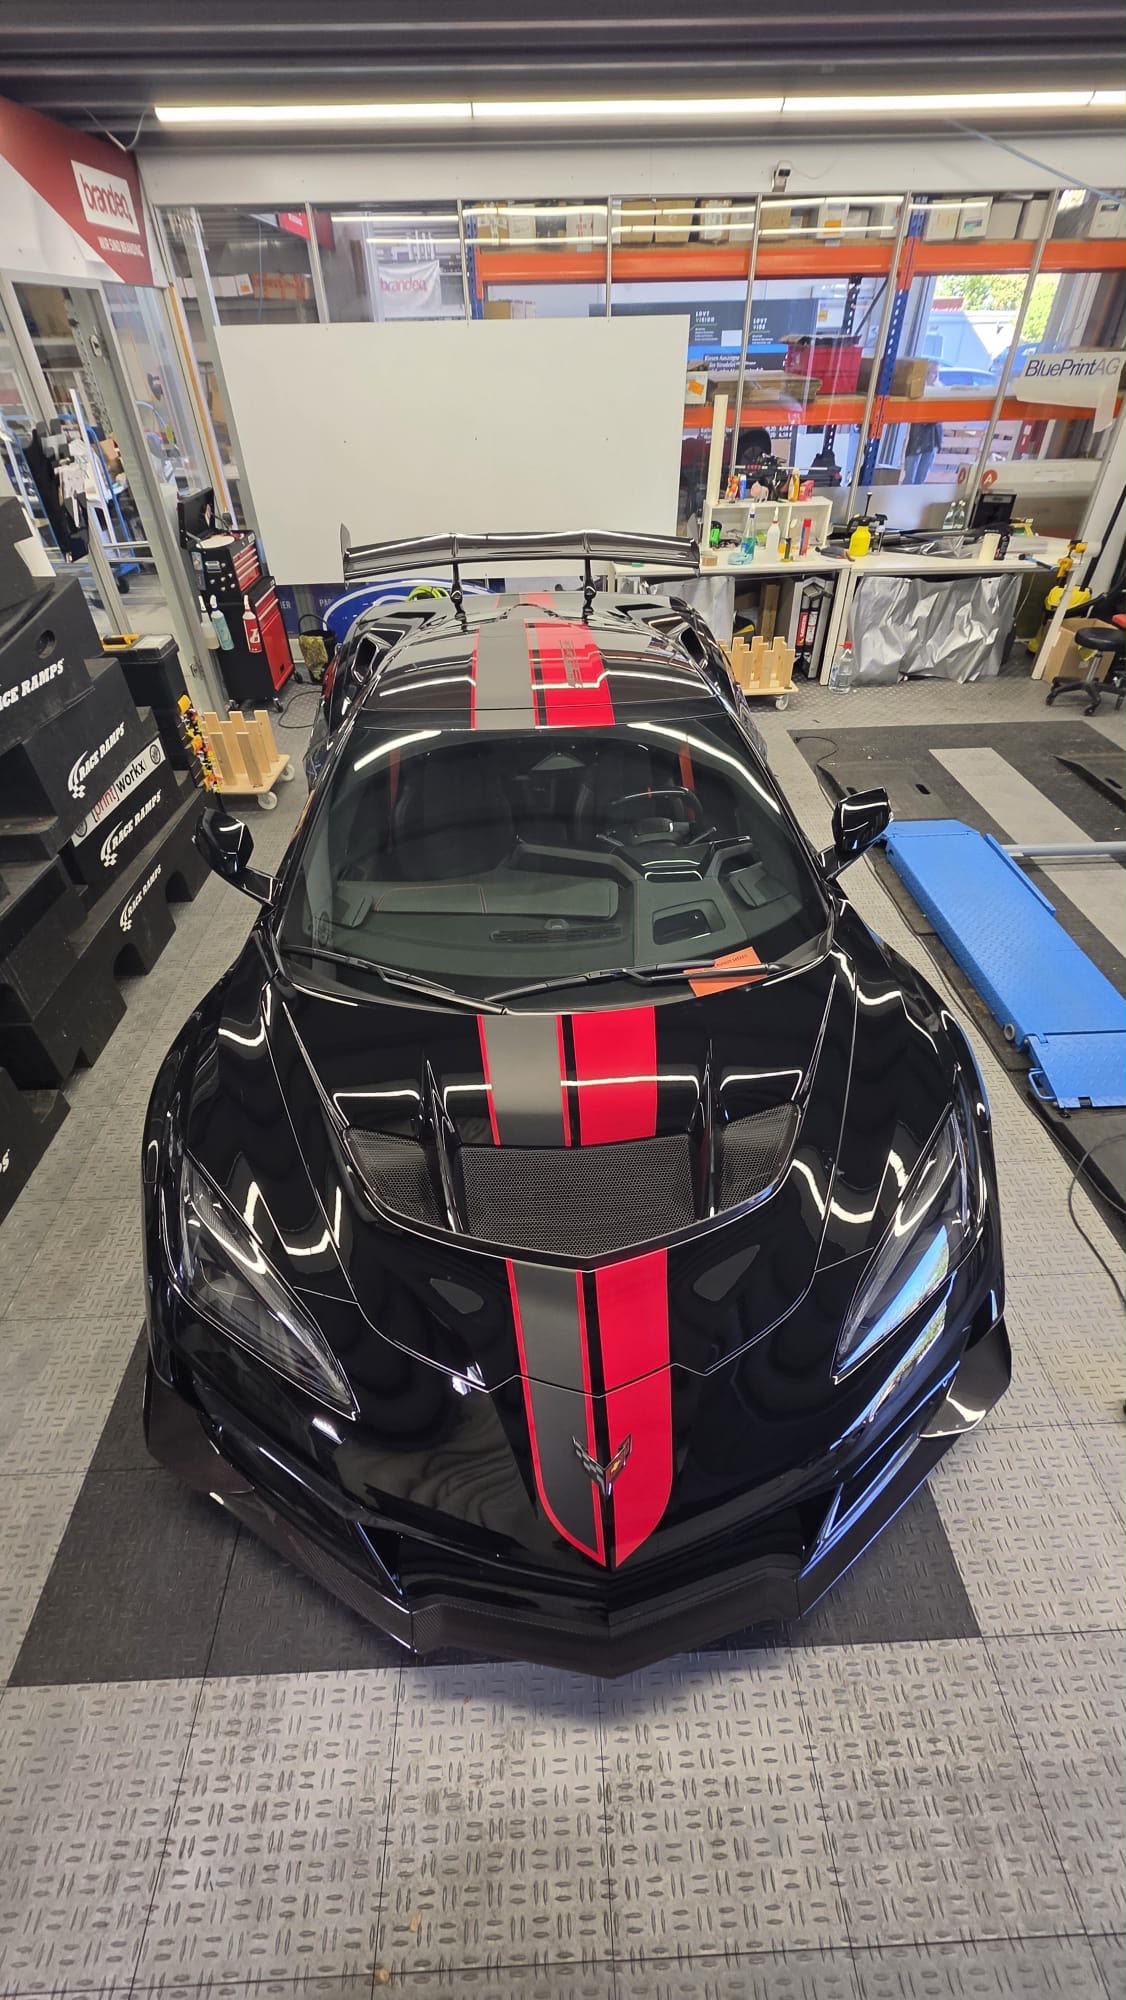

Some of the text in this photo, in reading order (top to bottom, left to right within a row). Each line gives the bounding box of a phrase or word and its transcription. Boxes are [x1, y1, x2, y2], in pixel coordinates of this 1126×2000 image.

[21, 660, 64, 697] RAMPS
[79, 724, 125, 781] RACE RAMPS
[112, 790, 162, 850] RACE RAMPS
[127, 865, 162, 917] RACE RAMPS
